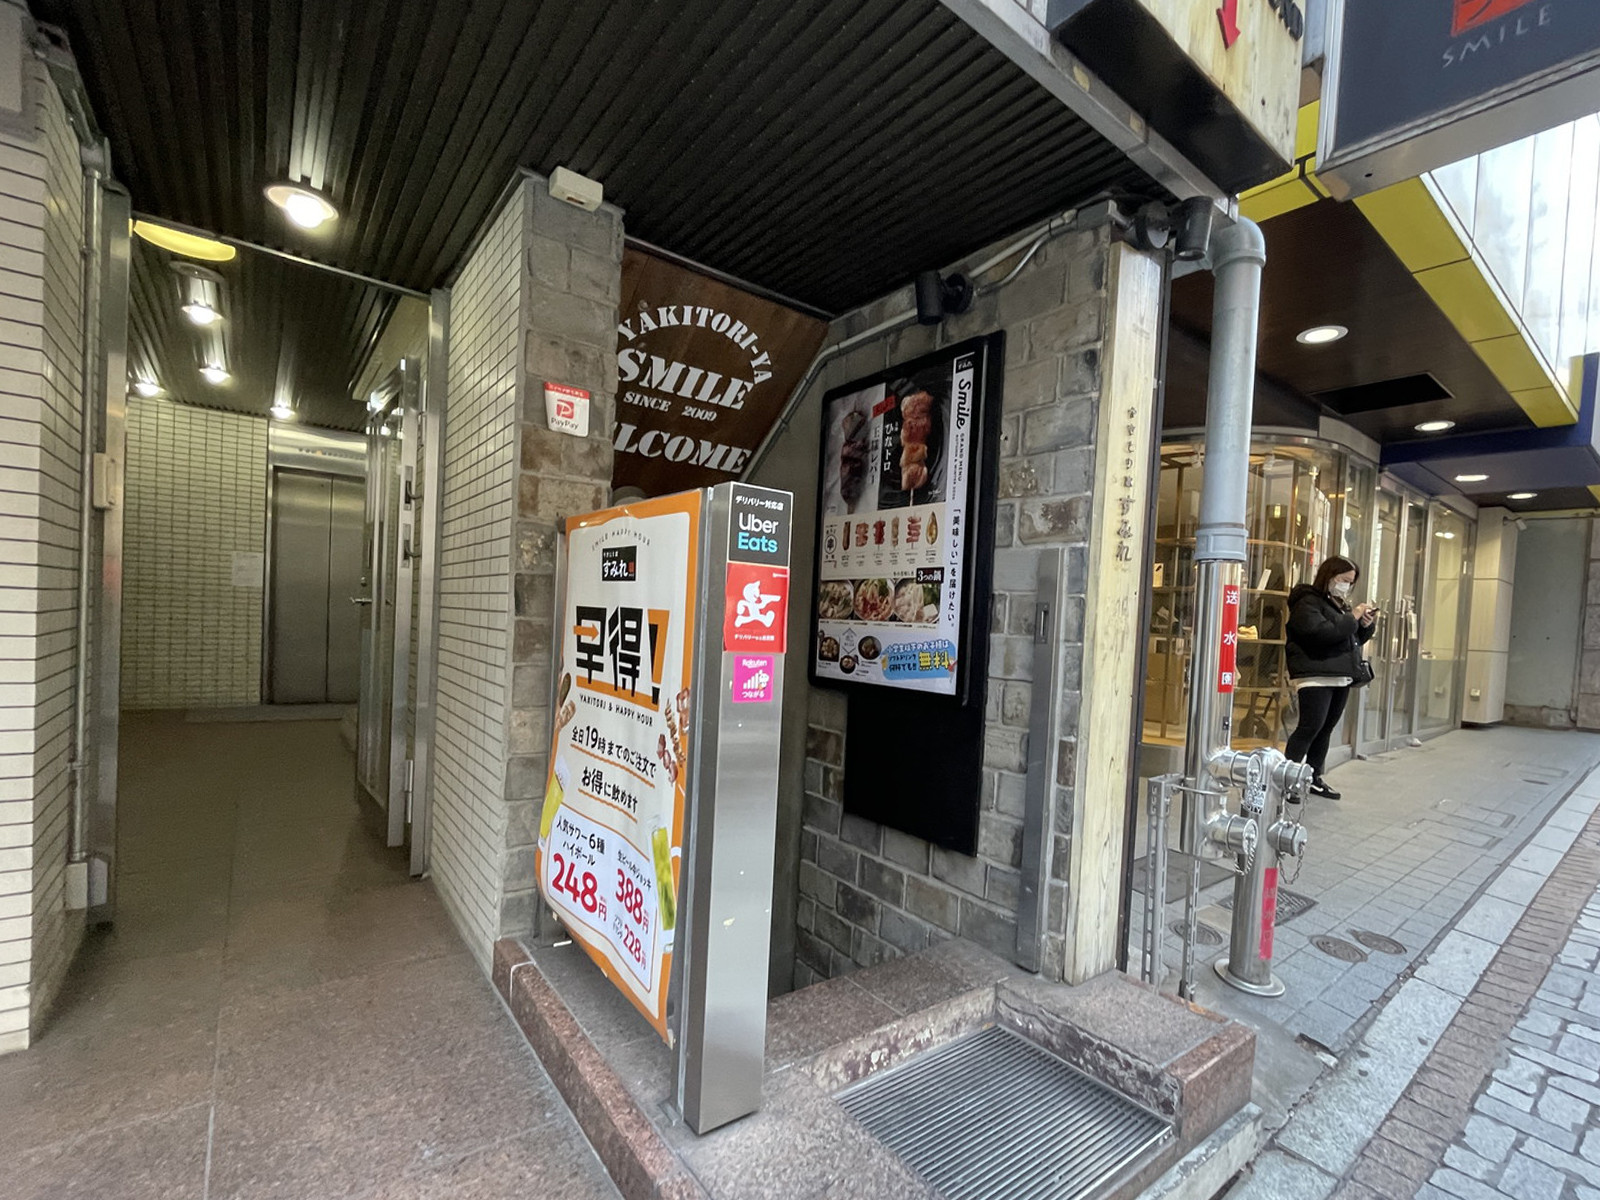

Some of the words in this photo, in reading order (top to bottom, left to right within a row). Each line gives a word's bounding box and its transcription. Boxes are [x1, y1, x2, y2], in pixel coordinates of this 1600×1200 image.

[1442, 4, 1552, 69] SMILE
[617, 305, 773, 385] YAKITORI-YA
[617, 348, 755, 410] SMILE
[623, 391, 672, 412] SINCE
[681, 405, 718, 422] 2009
[956, 378, 972, 430] Smile
[551, 417, 580, 430] PayPay
[613, 422, 753, 473] LCOME
[738, 512, 779, 534] Uber
[737, 531, 778, 553] Eats
[602, 559, 629, 578] すみれ
[918, 650, 949, 671] 無料
[579, 693, 607, 710] YAKITORI
[608, 702, 613, 712] &
[615, 704, 635, 720] HAPPY
[637, 712, 653, 727] HOUR
[741, 690, 765, 699] つながる
[571, 725, 657, 779] 全日19時までのご注文で
[581, 766, 638, 814] お得に飲めます
[556, 815, 605, 855] 人気サワー6種
[563, 840, 596, 866] ハイボール
